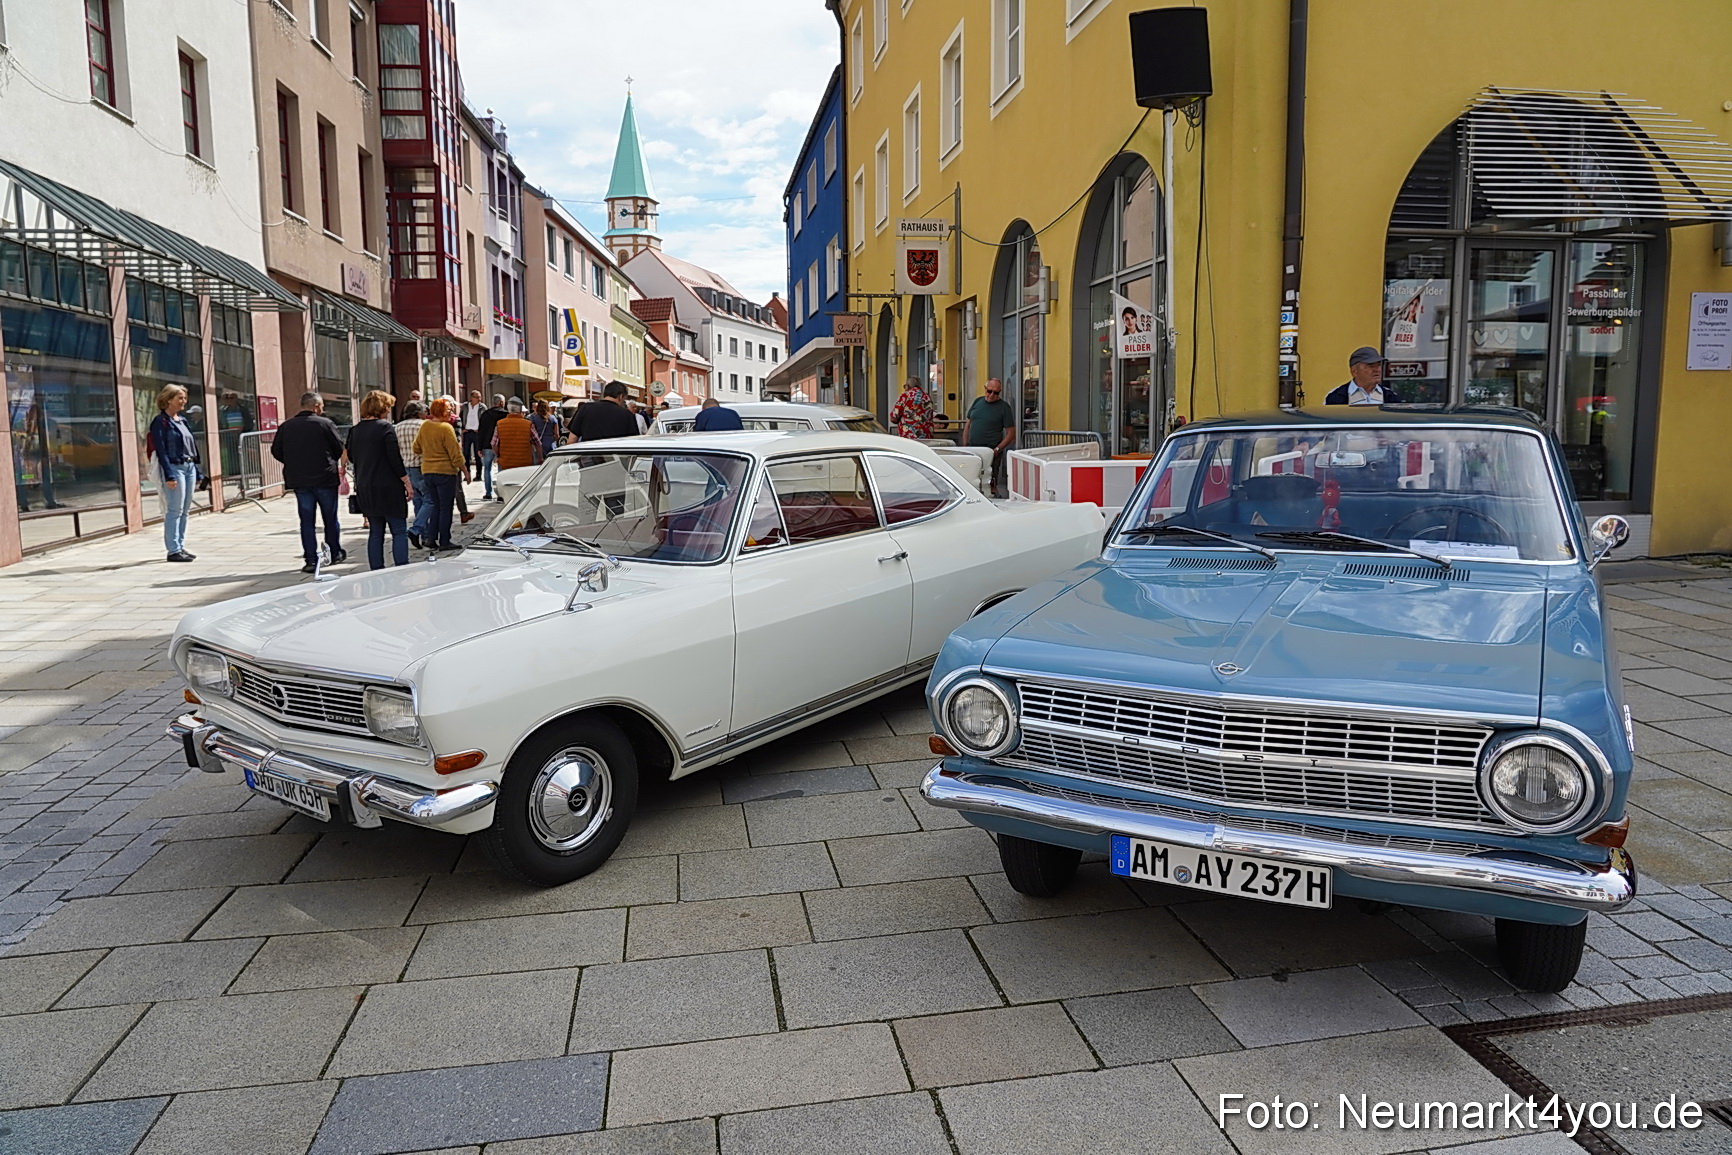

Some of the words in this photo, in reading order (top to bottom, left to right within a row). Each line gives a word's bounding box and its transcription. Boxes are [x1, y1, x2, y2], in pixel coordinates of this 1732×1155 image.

[901, 223, 937, 232] RATHAUS
[1582, 288, 1628, 299] Passbilder
[1712, 299, 1729, 307] FOTO
[1567, 306, 1643, 319] Bewerbungsbilder
[1711, 307, 1728, 315] PROFI
[836, 322, 857, 336] Sarah
[857, 323, 864, 335] K
[1590, 326, 1615, 335] sofort
[1128, 335, 1147, 344] PASS
[1394, 333, 1414, 343] BILDER
[566, 337, 578, 350] B
[1124, 343, 1151, 353] BILDER
[327, 714, 361, 724] OPEL
[1117, 859, 1125, 869] D
[1131, 843, 1169, 878] AM
[1194, 854, 1234, 889] AY
[1240, 861, 1327, 904] 237H
